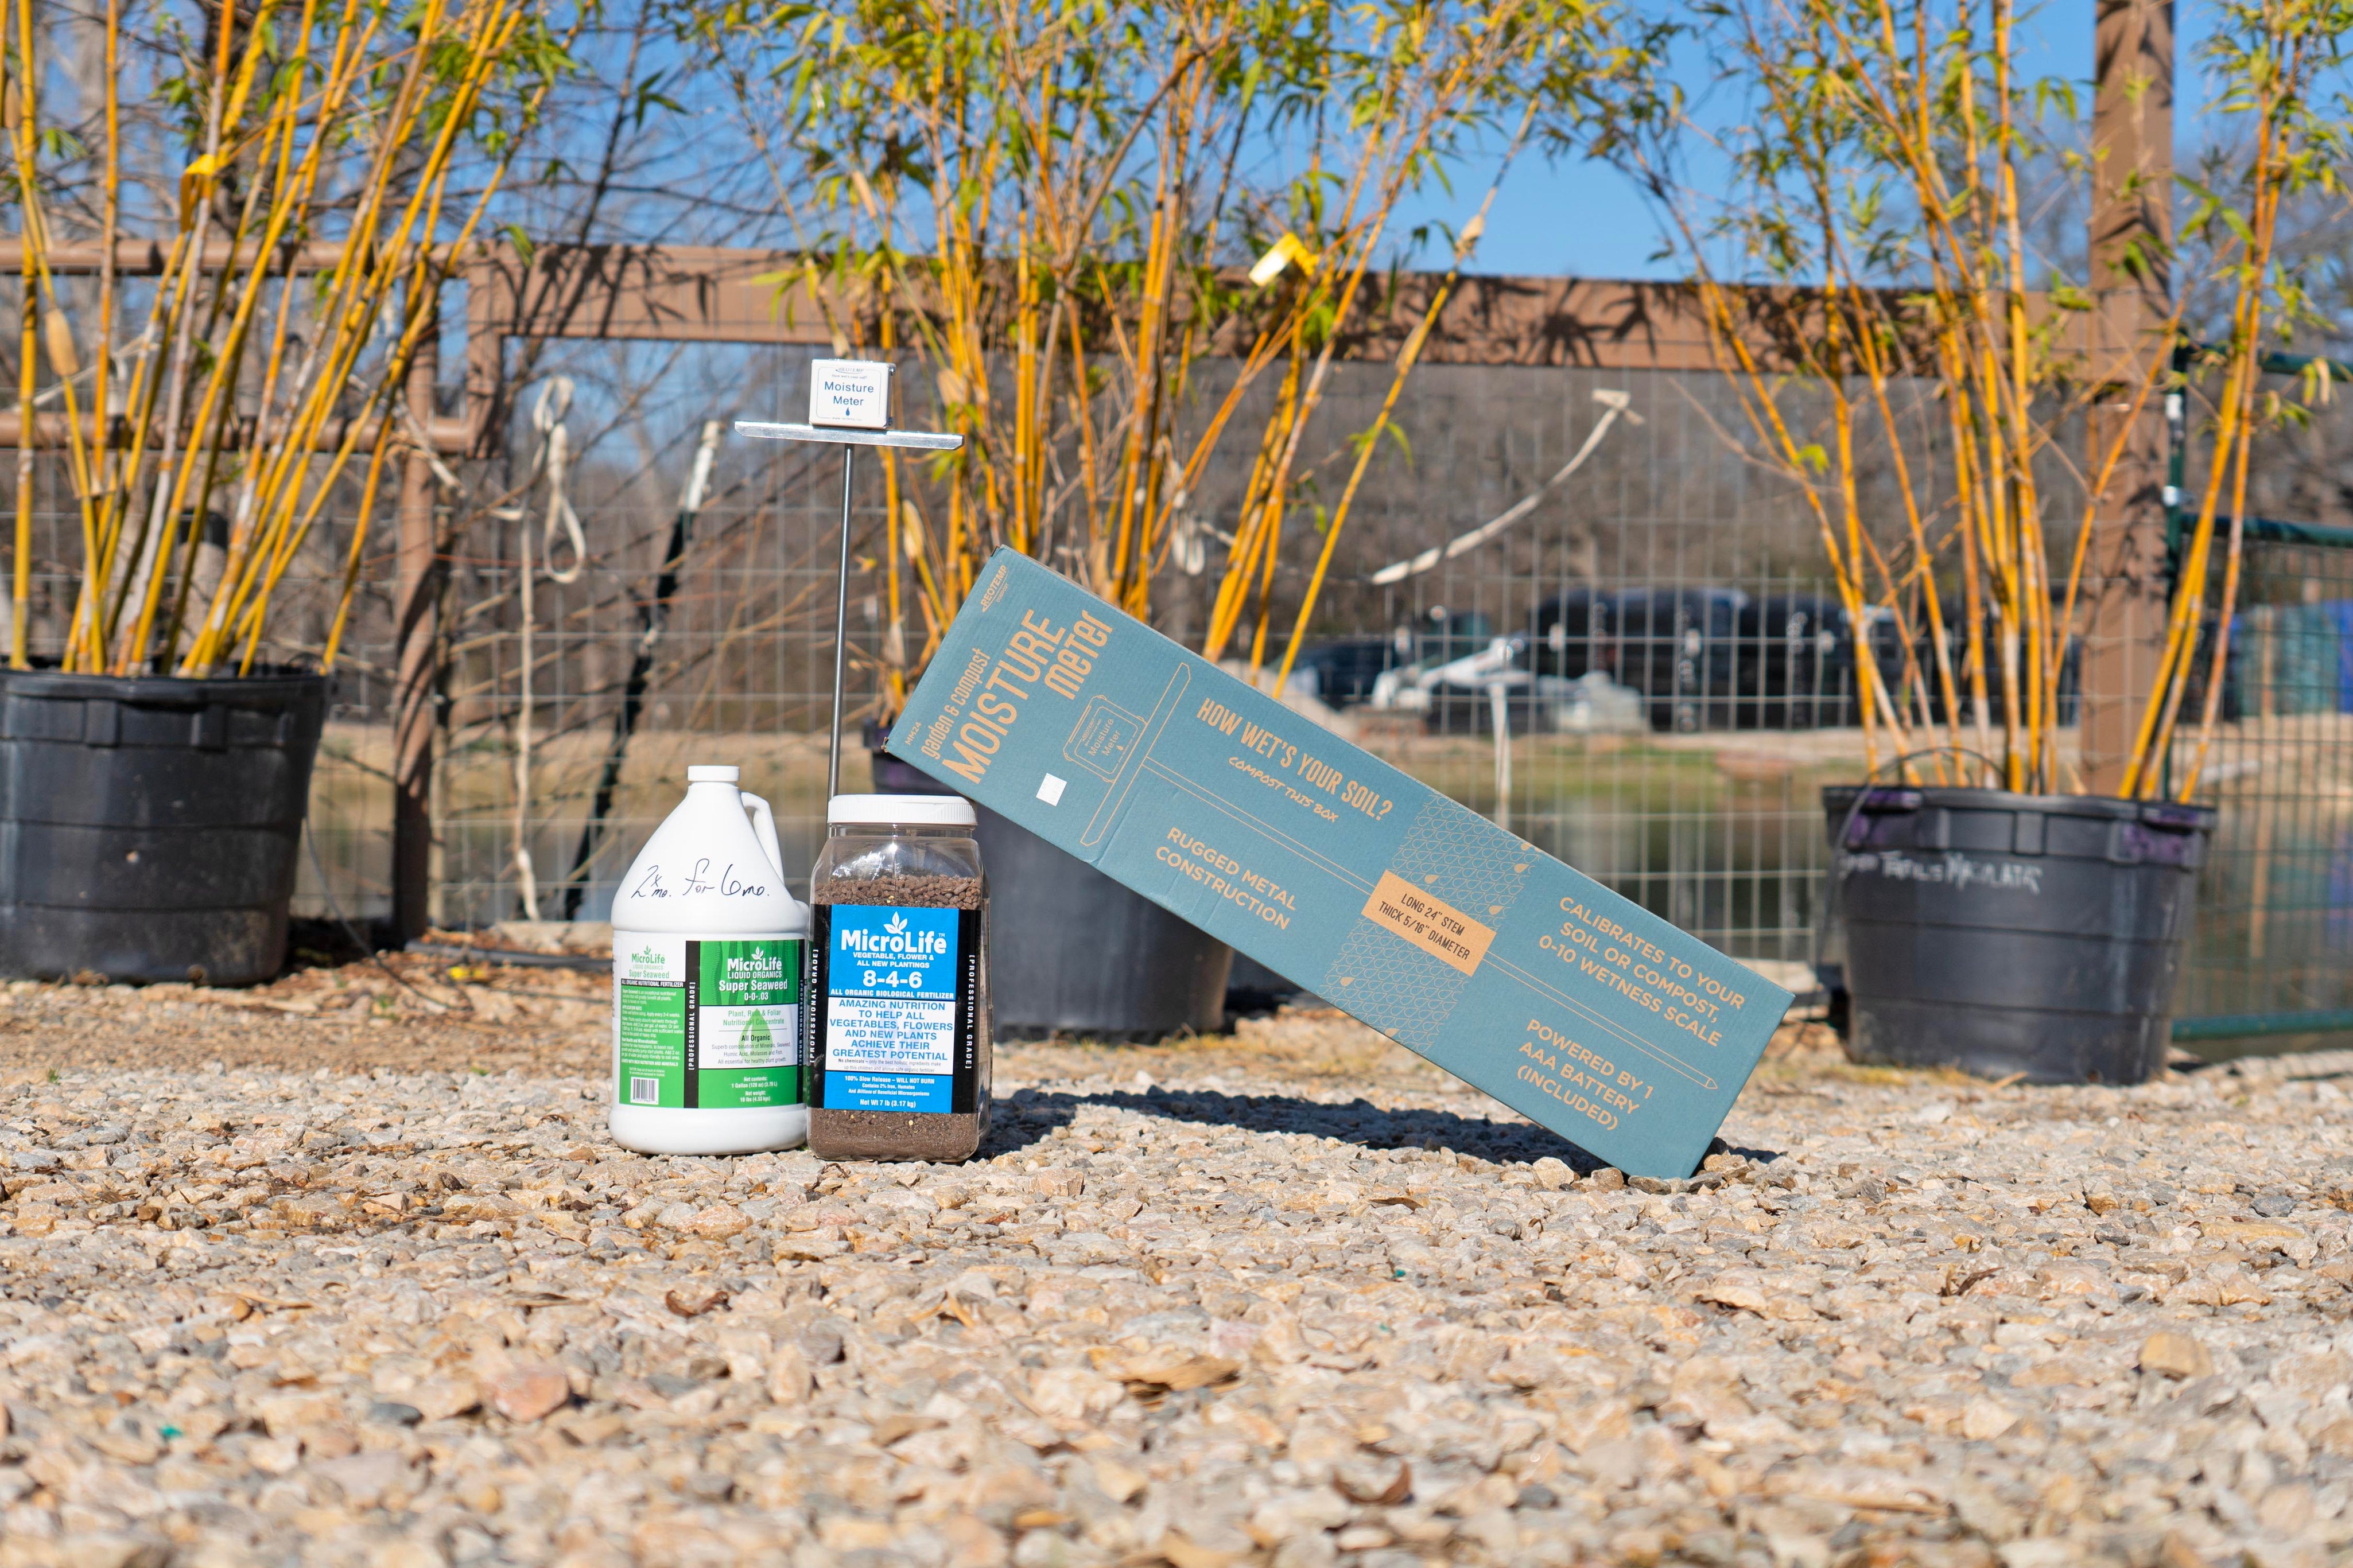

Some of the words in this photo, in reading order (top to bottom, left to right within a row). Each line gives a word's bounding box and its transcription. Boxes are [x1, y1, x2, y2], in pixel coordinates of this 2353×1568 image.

[824, 381, 874, 393] Moisture
[833, 395, 864, 406] Meter
[980, 565, 1008, 608] REOTEMP
[950, 648, 990, 706] compost
[942, 609, 1065, 784] MOISTURE
[944, 705, 960, 716] &
[904, 722, 922, 745] MM24
[921, 705, 960, 760] garden
[1088, 719, 1113, 756] Moisture
[1102, 730, 1120, 756] Meter
[1197, 698, 1242, 735] HOW
[1241, 722, 1297, 768] WET'S
[1298, 753, 1342, 794] YOUR
[1341, 780, 1392, 820] SOIL?
[1229, 757, 1286, 789] COMPOST
[1286, 787, 1313, 807] THIS
[1314, 804, 1338, 822] BOX
[682, 858, 715, 896] for
[1167, 827, 1239, 874] RUGGED
[1242, 870, 1295, 910] METAL
[1156, 846, 1290, 929] CONSTRUCTION
[1401, 894, 1424, 912] LONG
[1424, 908, 1438, 920] 24"
[1442, 917, 1465, 936] STEM
[841, 928, 947, 954] MicroLife
[1380, 901, 1404, 922] THICK
[1404, 916, 1424, 933] 5/16"
[1428, 931, 1470, 959] DIAMETER
[631, 953, 665, 964] MicroLife
[727, 957, 782, 971] MicroLife
[853, 952, 895, 960] VEGETABLE,
[1560, 897, 1665, 963] CALIBRATES
[1669, 957, 1692, 978] TO
[1698, 972, 1745, 1009] YOUR
[629, 969, 642, 979] Super
[643, 970, 670, 979] Seaweed
[752, 971, 783, 979] ORGANICS
[863, 970, 922, 989] 8-4-6
[1560, 923, 1598, 953] SOIL
[1604, 947, 1631, 970] OR
[1633, 964, 1719, 1022] COMPOST,
[719, 980, 749, 993] Super
[751, 979, 788, 991] Seaweed
[744, 992, 770, 1001] 0-0-.03
[845, 989, 874, 997] ORGANIC
[967, 955, 975, 1030] [PROFESSIONAL
[1539, 935, 1576, 962] 0-10
[1581, 957, 1662, 1012] WETNESS
[1664, 1006, 1722, 1046] SCALE
[839, 999, 886, 1009] AMAZING
[890, 1001, 945, 1010] NUTRITION
[859, 1010, 872, 1018] TO
[876, 1010, 902, 1019] HELP
[906, 1011, 925, 1020] ALL
[830, 1019, 899, 1030] VEGETABLES,
[904, 1022, 953, 1031] FLOWERS
[845, 1029, 867, 1037] AND
[870, 1030, 893, 1038] NEW
[897, 1032, 937, 1040] PLANTS
[833, 1049, 887, 1059] GREATEST
[890, 1051, 948, 1061] POTENTIAL
[851, 1040, 895, 1048] ACHIEVE
[899, 1041, 930, 1050] THEIR
[965, 1034, 973, 1069] GRADE]
[1527, 1020, 1614, 1076] POWERED
[1617, 1071, 1643, 1090] BY
[1645, 1085, 1653, 1098] 1
[1519, 1042, 1556, 1070] AAA
[1560, 1064, 1639, 1114] BATTERY
[1517, 1065, 1618, 1130] (INCLUDED)
